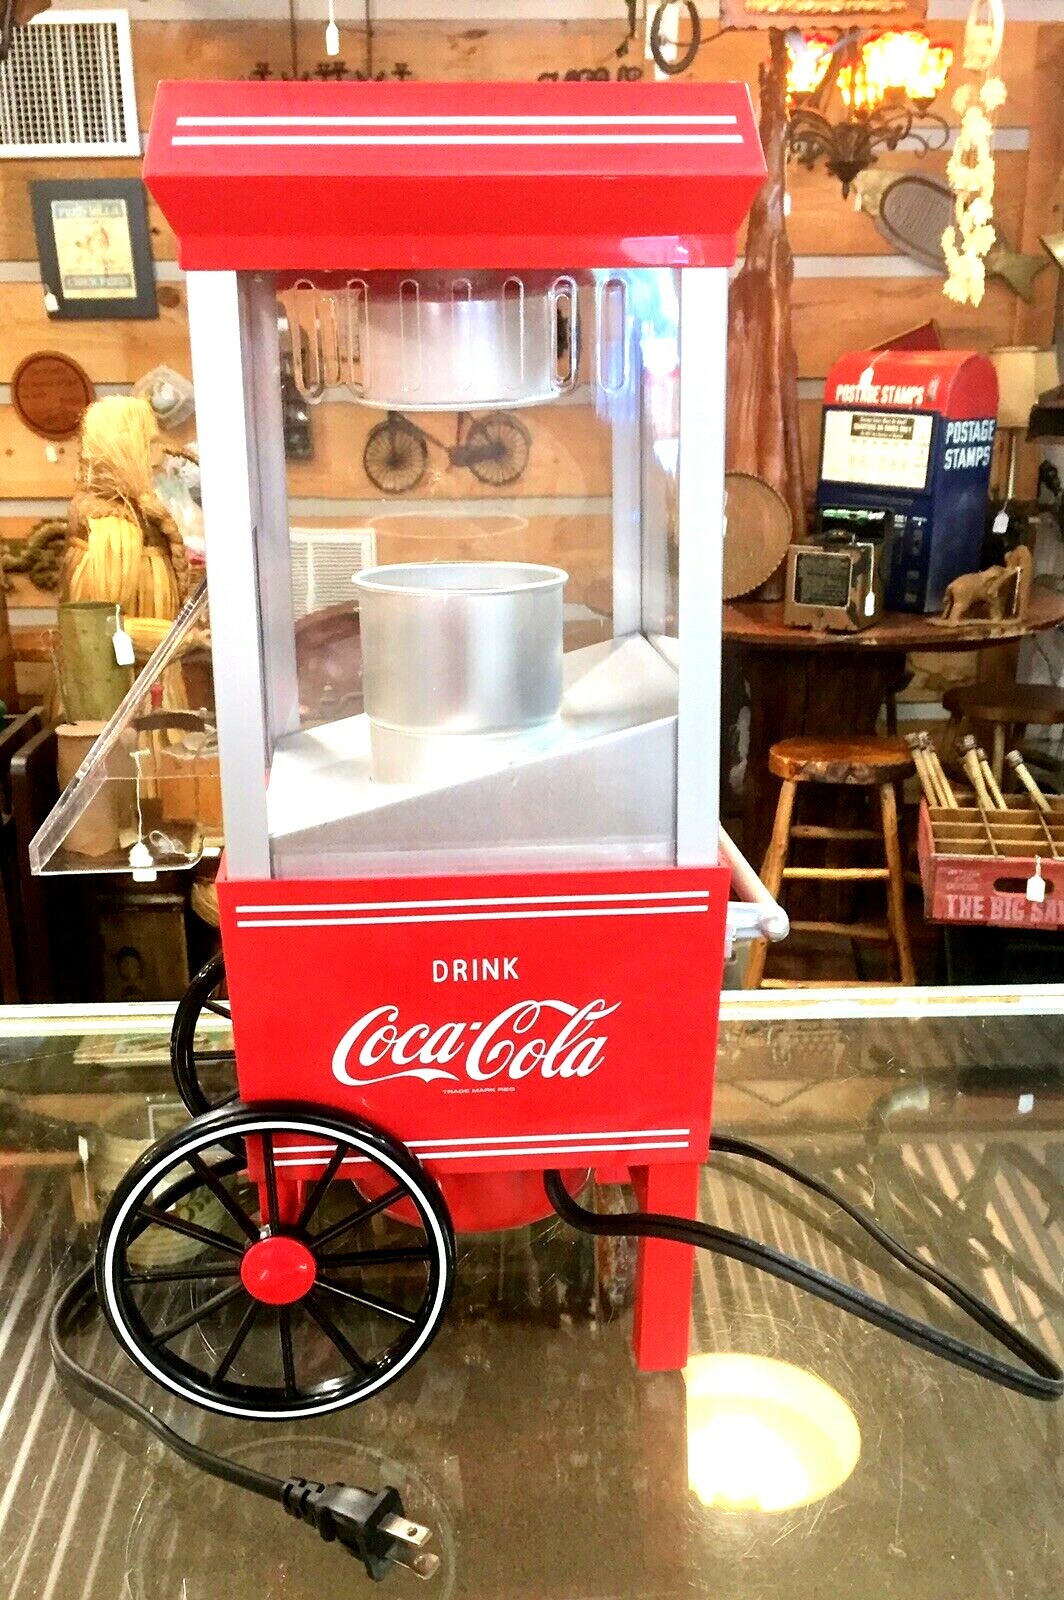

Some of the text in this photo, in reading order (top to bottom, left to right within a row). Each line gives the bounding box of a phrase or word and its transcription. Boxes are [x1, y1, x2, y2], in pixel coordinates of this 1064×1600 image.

[880, 385, 925, 406] STAMPS
[945, 420, 996, 444] POSTAGE
[943, 446, 991, 470] STAMPS
[945, 894, 985, 919] THE
[990, 896, 1025, 920] BIG
[432, 957, 520, 983] DRINK
[331, 998, 622, 1086] Coca-Cola
